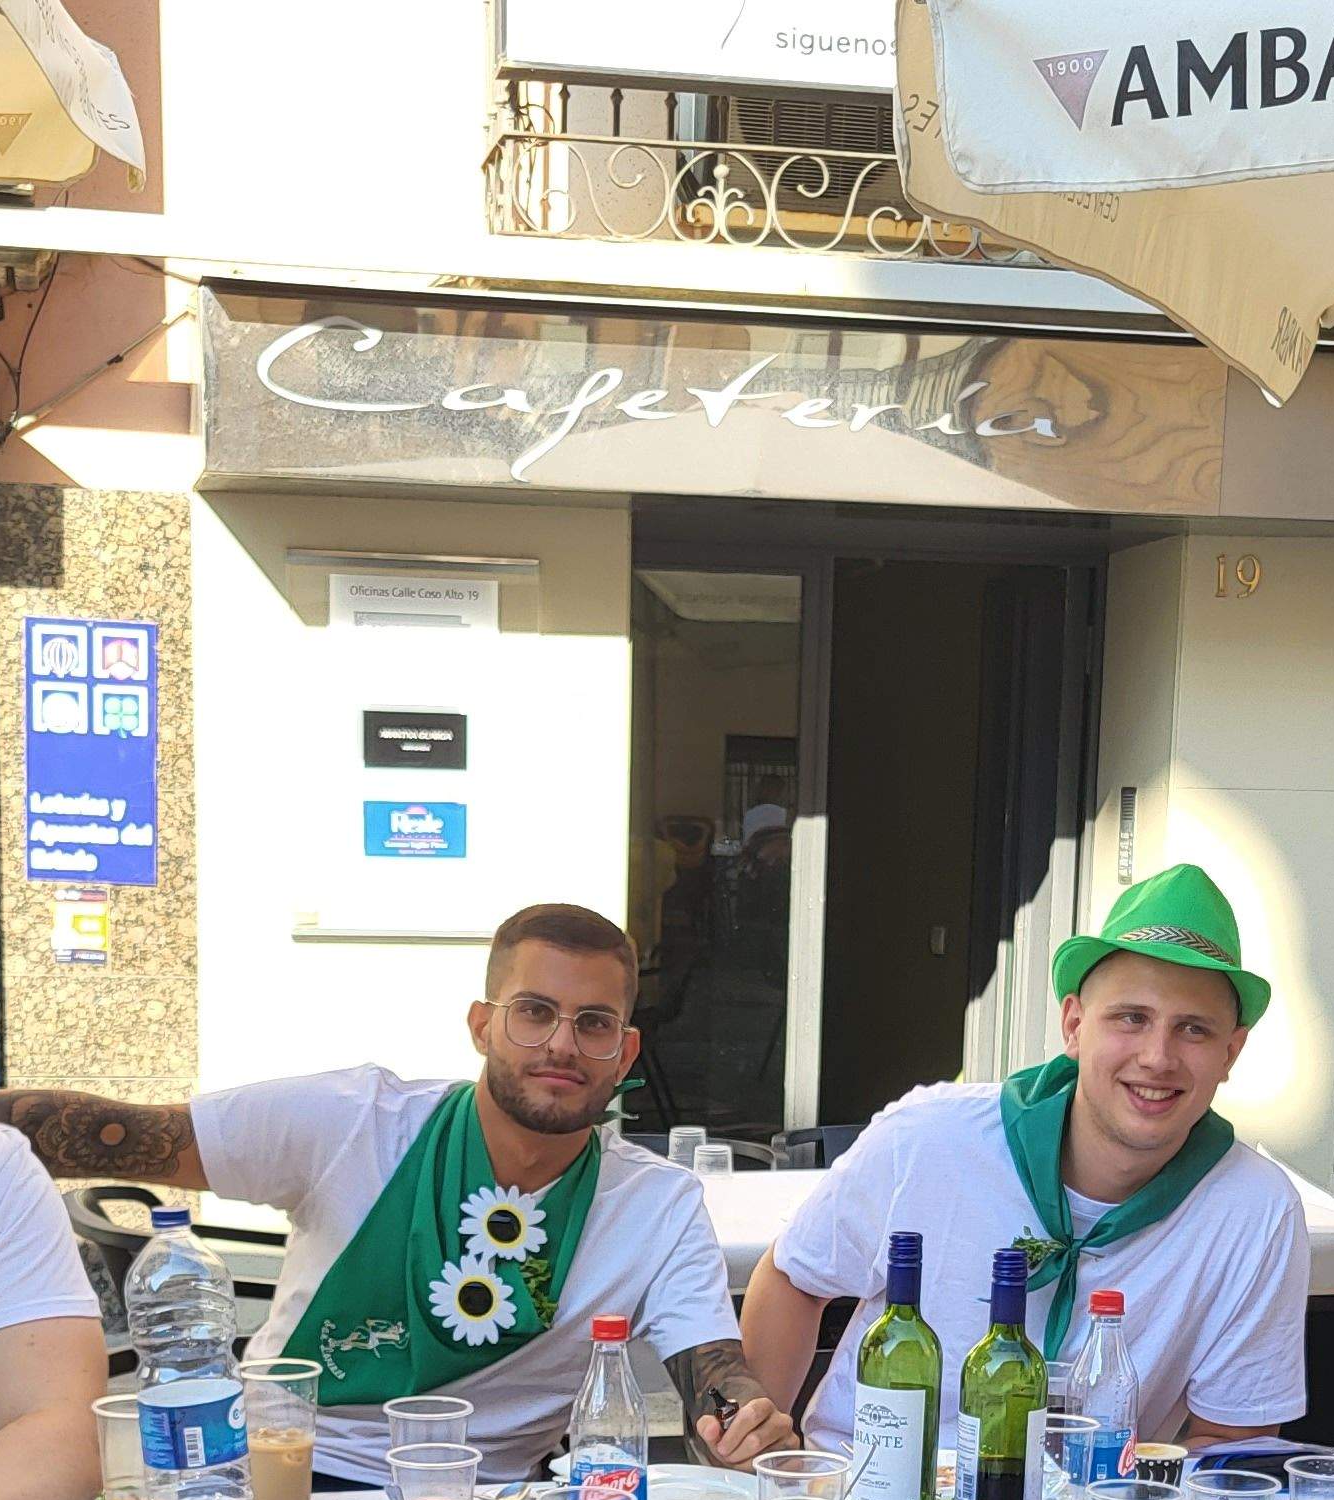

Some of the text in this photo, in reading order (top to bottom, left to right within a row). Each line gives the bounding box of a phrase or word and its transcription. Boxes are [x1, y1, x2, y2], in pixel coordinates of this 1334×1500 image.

[1046, 55, 1096, 78] 1900
[257, 315, 1061, 482] Cafetería
[350, 585, 479, 601] Oficinas Calle Coso Alto 19
[1214, 555, 1262, 598] 19
